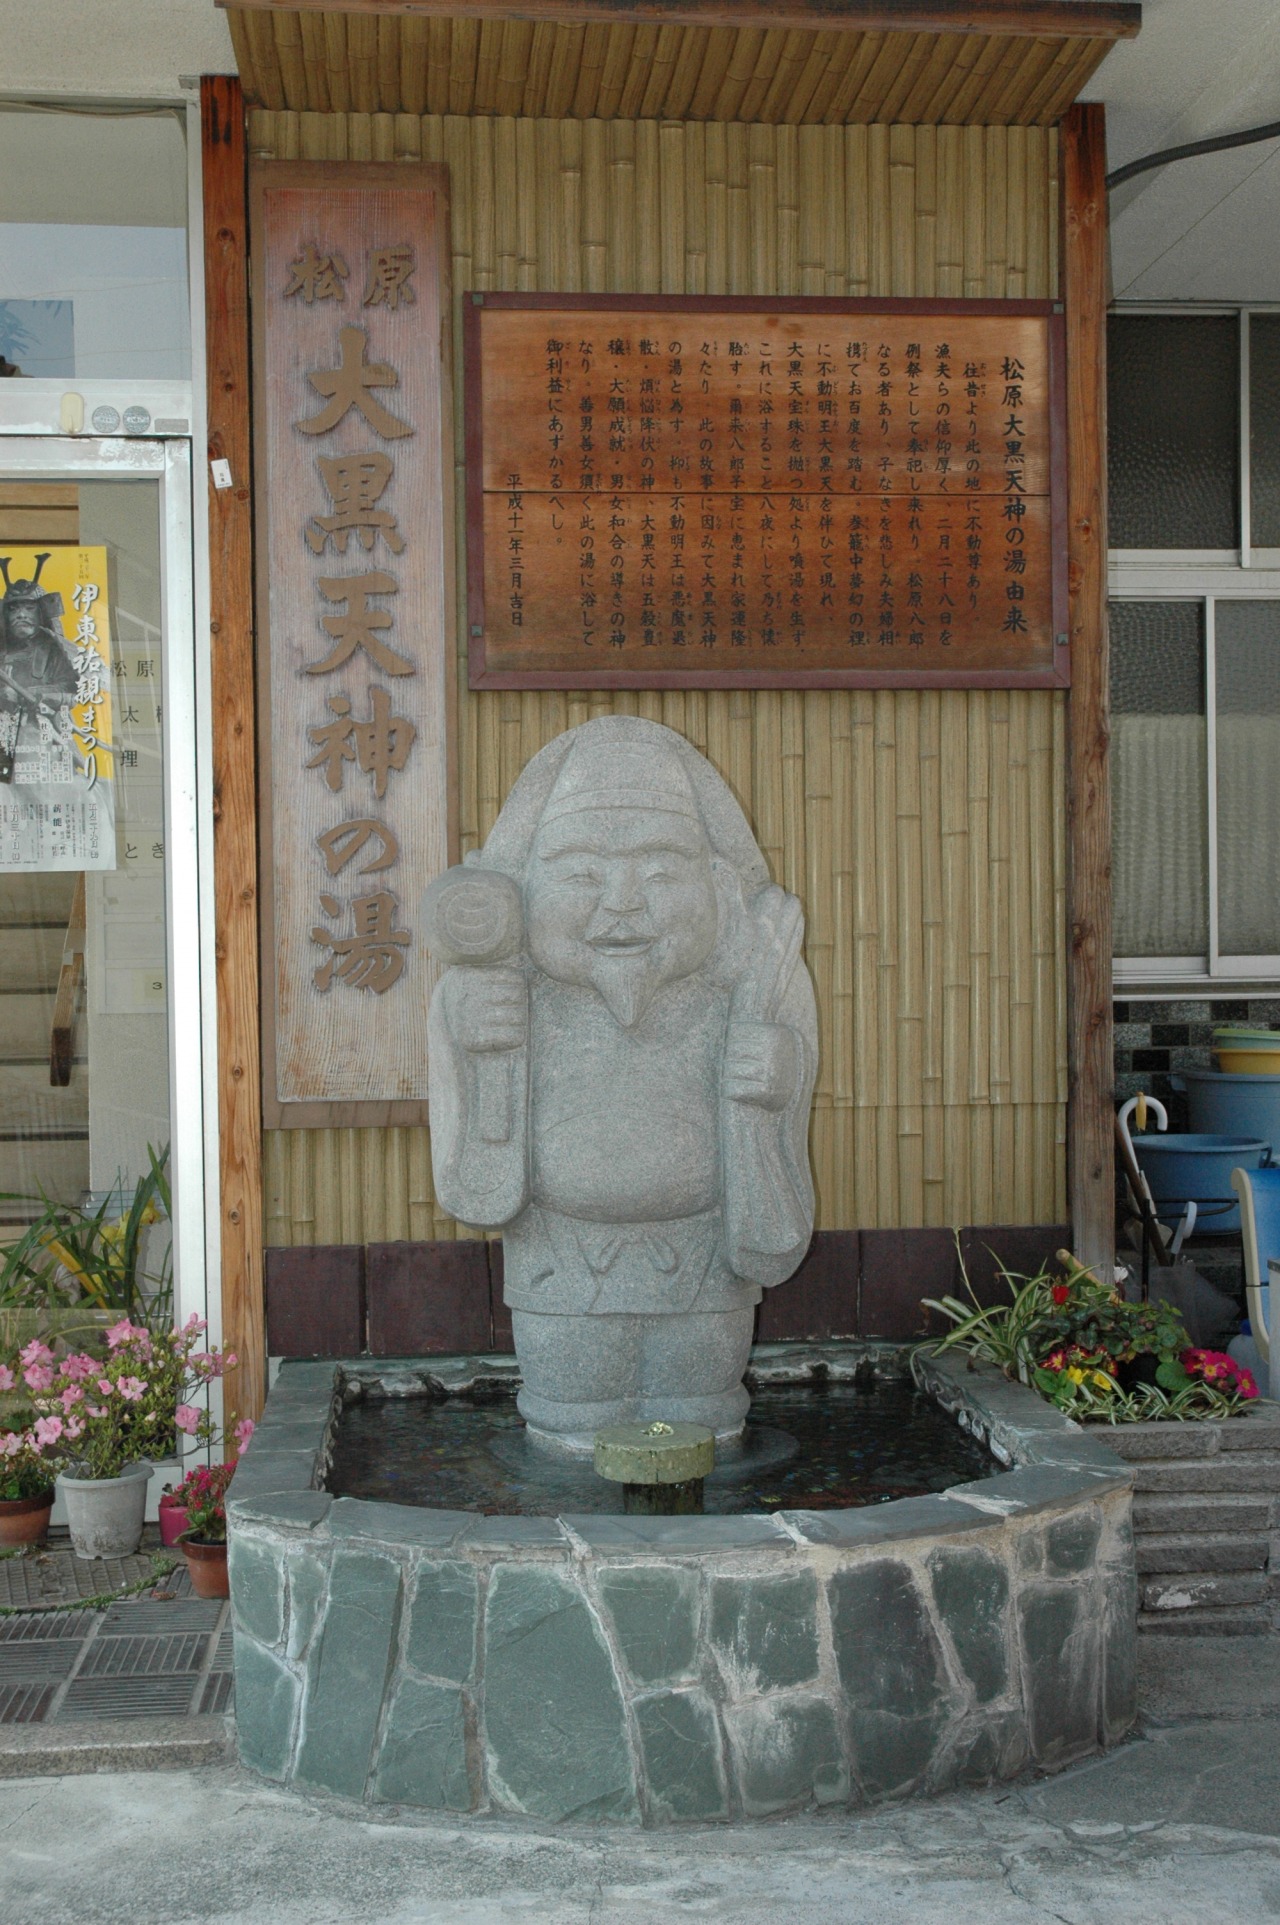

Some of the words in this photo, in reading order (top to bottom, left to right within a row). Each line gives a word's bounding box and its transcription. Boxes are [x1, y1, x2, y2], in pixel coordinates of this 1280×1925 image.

[283, 244, 415, 310] 松原
[507, 474, 525, 627] 平成十一年三月吉日
[1000, 356, 1027, 634] 松原大黒天神の湯由来
[72, 583, 104, 791] 伊東祐親まつり
[294, 325, 415, 994] 大黒天神の湯
